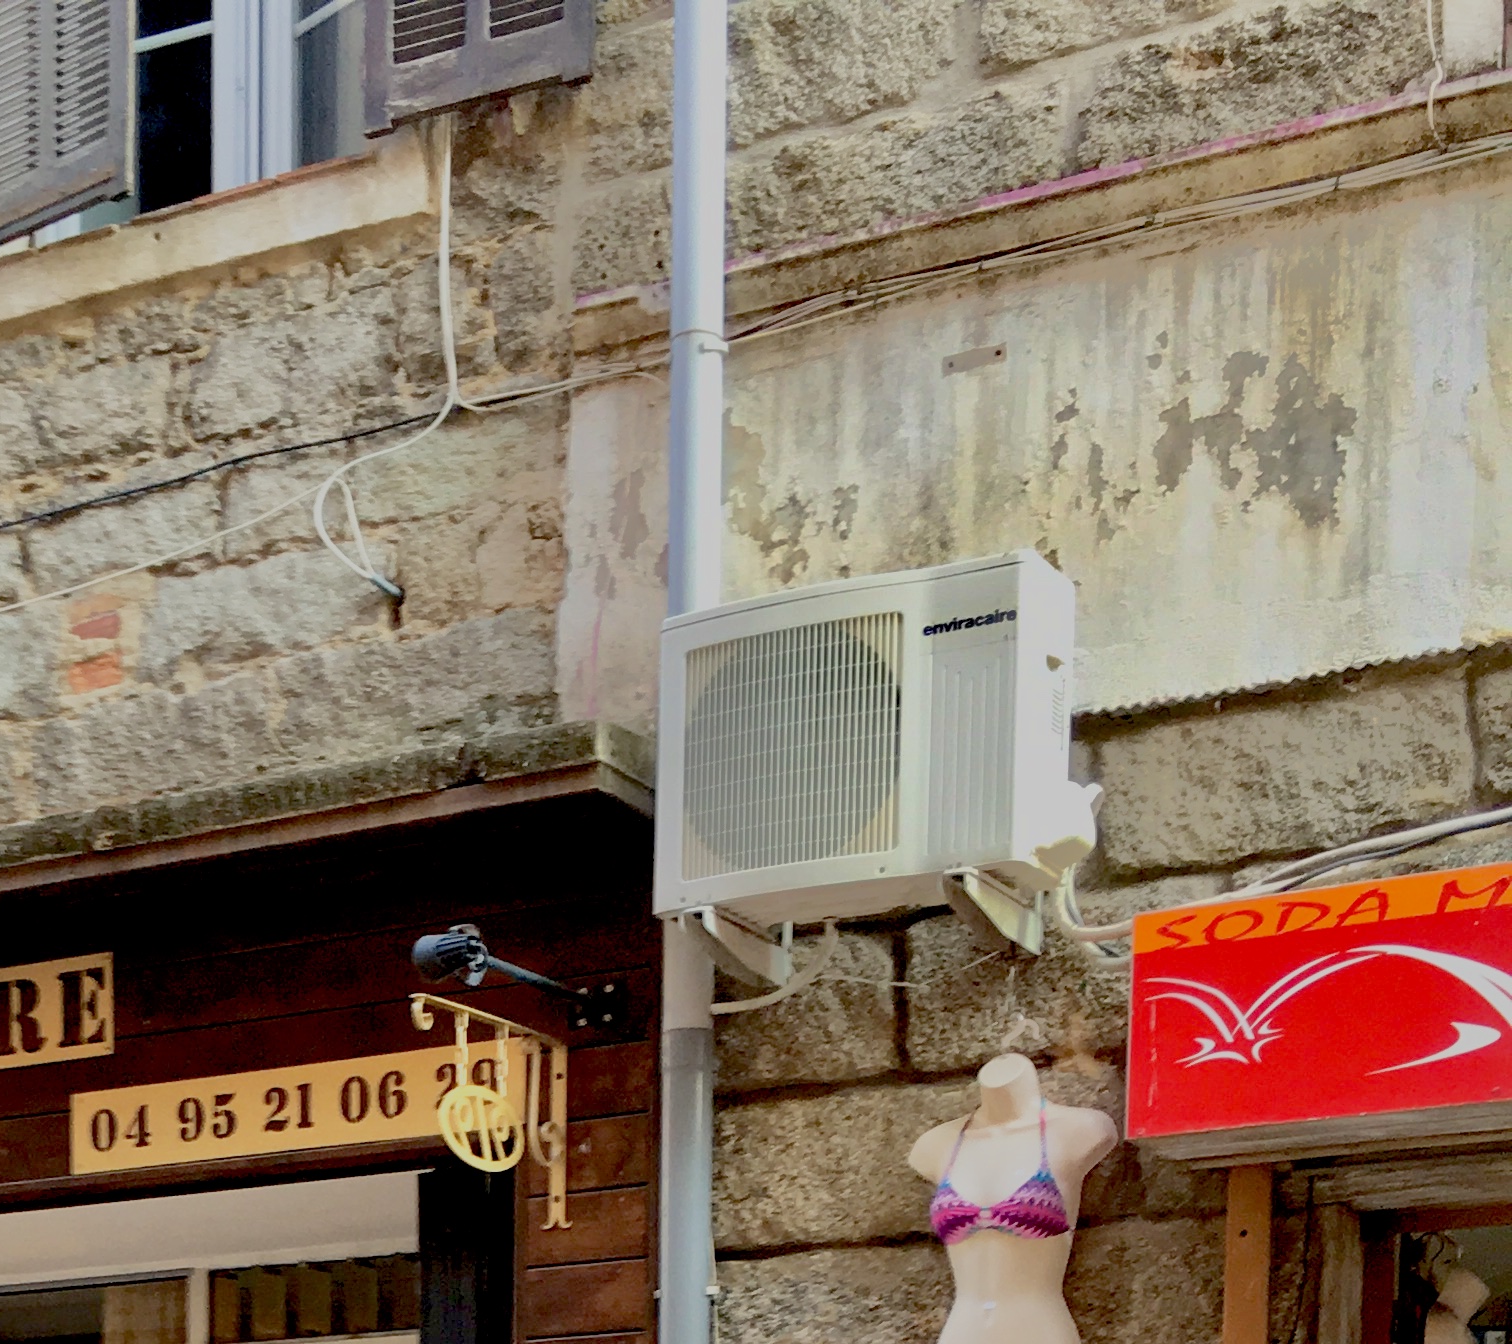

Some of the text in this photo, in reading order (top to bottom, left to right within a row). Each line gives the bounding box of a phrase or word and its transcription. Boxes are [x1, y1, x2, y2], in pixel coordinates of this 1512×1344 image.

[923, 609, 1017, 636] enviracaire
[1156, 888, 1391, 950] SODA
[90, 1104, 152, 1152] 04
[178, 1092, 238, 1142] 95
[263, 1082, 314, 1132] 21
[340, 1069, 408, 1123] 06
